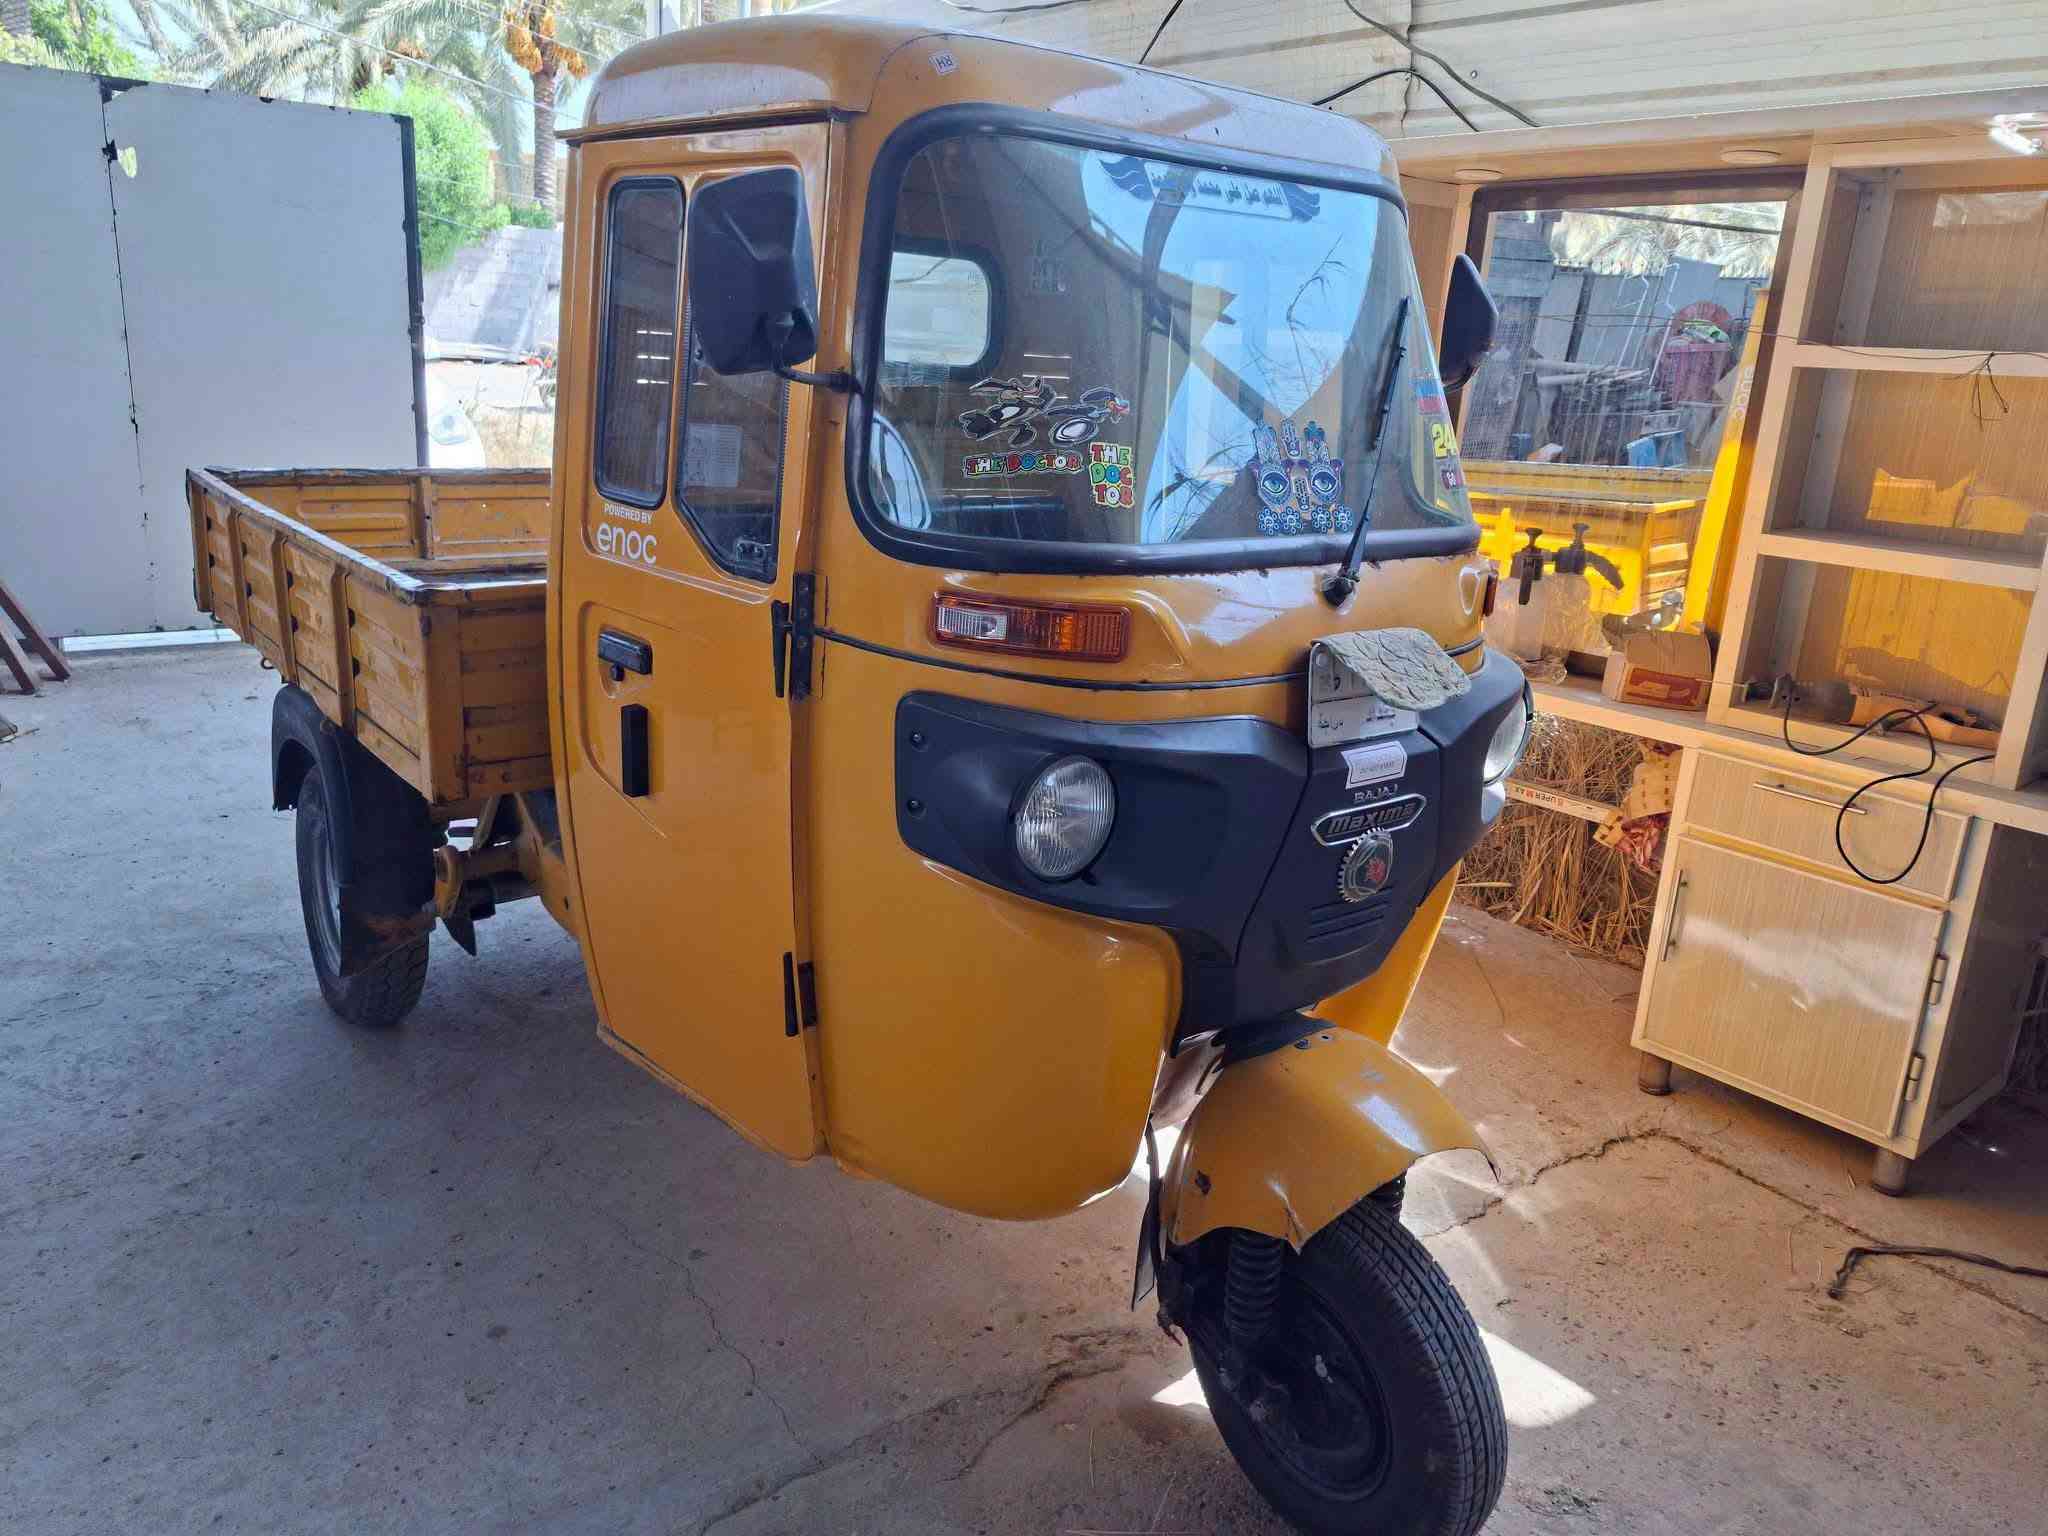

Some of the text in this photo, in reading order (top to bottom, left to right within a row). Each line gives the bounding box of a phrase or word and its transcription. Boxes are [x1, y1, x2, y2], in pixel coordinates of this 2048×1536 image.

[966, 452, 1082, 476] THE DOCTOR
[1091, 443, 1131, 465] THE
[1090, 463, 1133, 485] DOC
[1095, 484, 1134, 506] TOR
[604, 503, 653, 524] POWERED BY
[597, 523, 657, 564] enoc
[1354, 784, 1398, 803] BAJAJ
